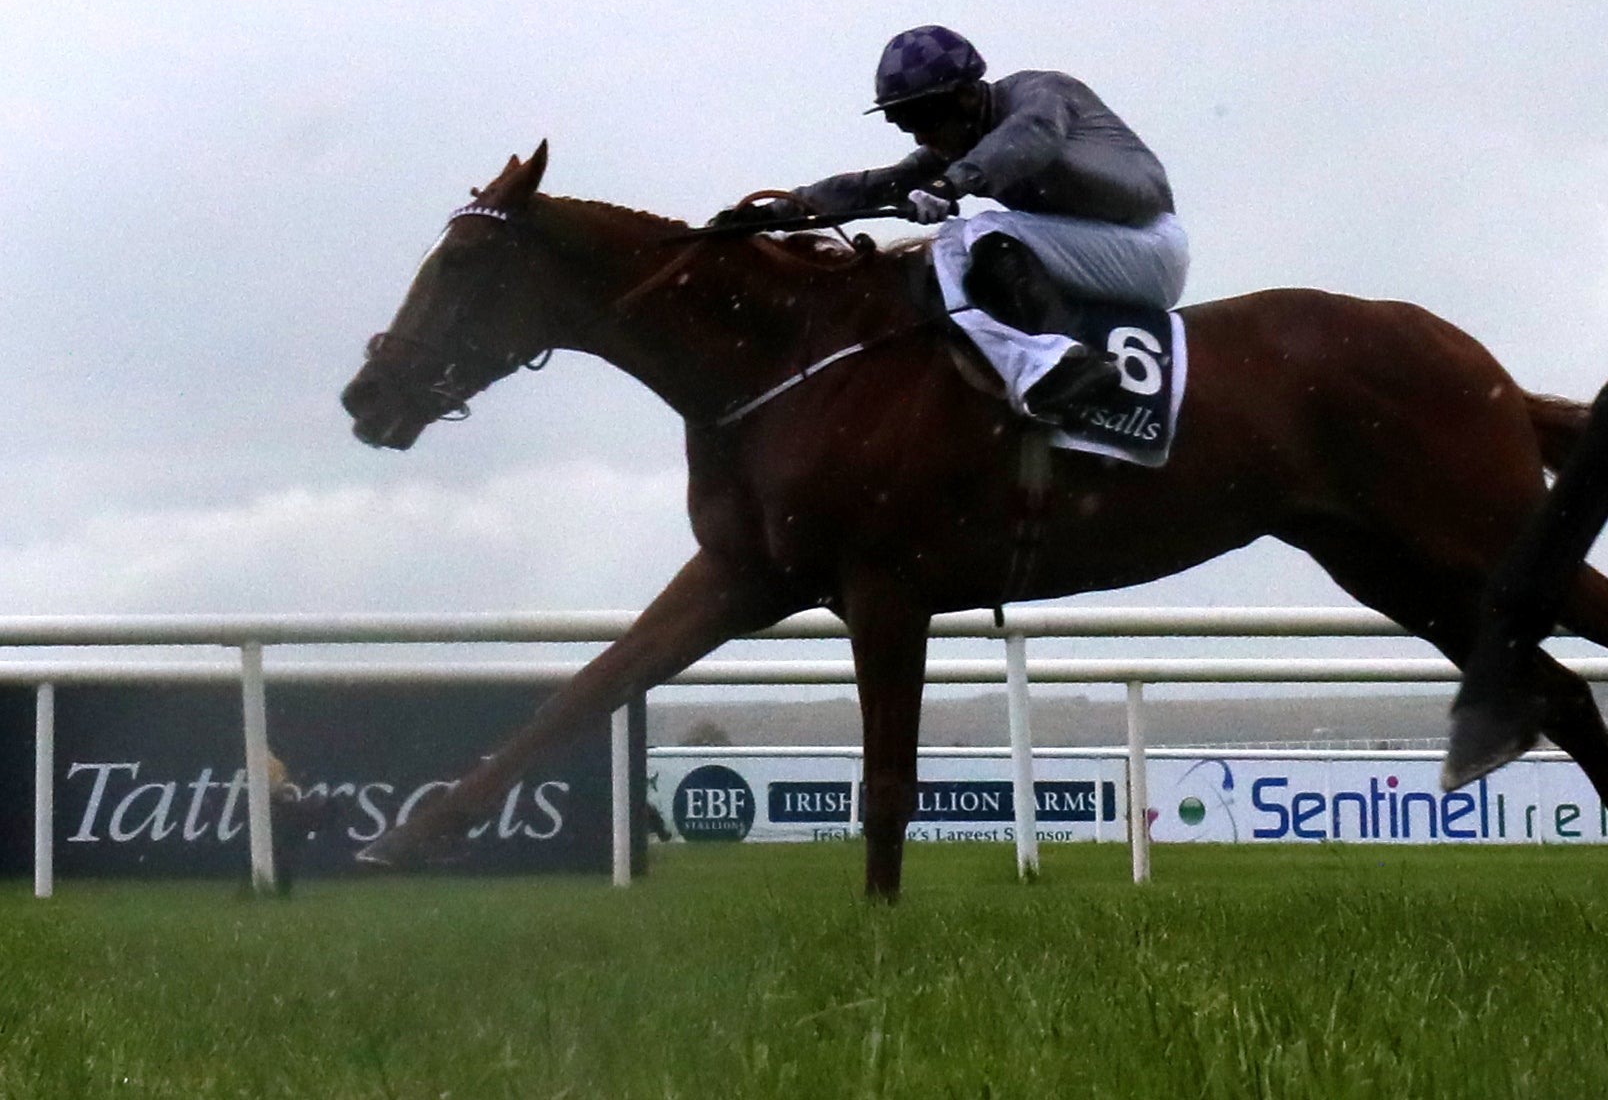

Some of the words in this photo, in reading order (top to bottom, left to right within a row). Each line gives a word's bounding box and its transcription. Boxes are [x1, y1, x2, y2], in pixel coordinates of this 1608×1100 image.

[1106, 326, 1163, 396] 6
[684, 787, 746, 821] EBF
[1251, 775, 1489, 839] Sentinel
[935, 827, 998, 842] Largest
[1003, 827, 1073, 842] Snsor
